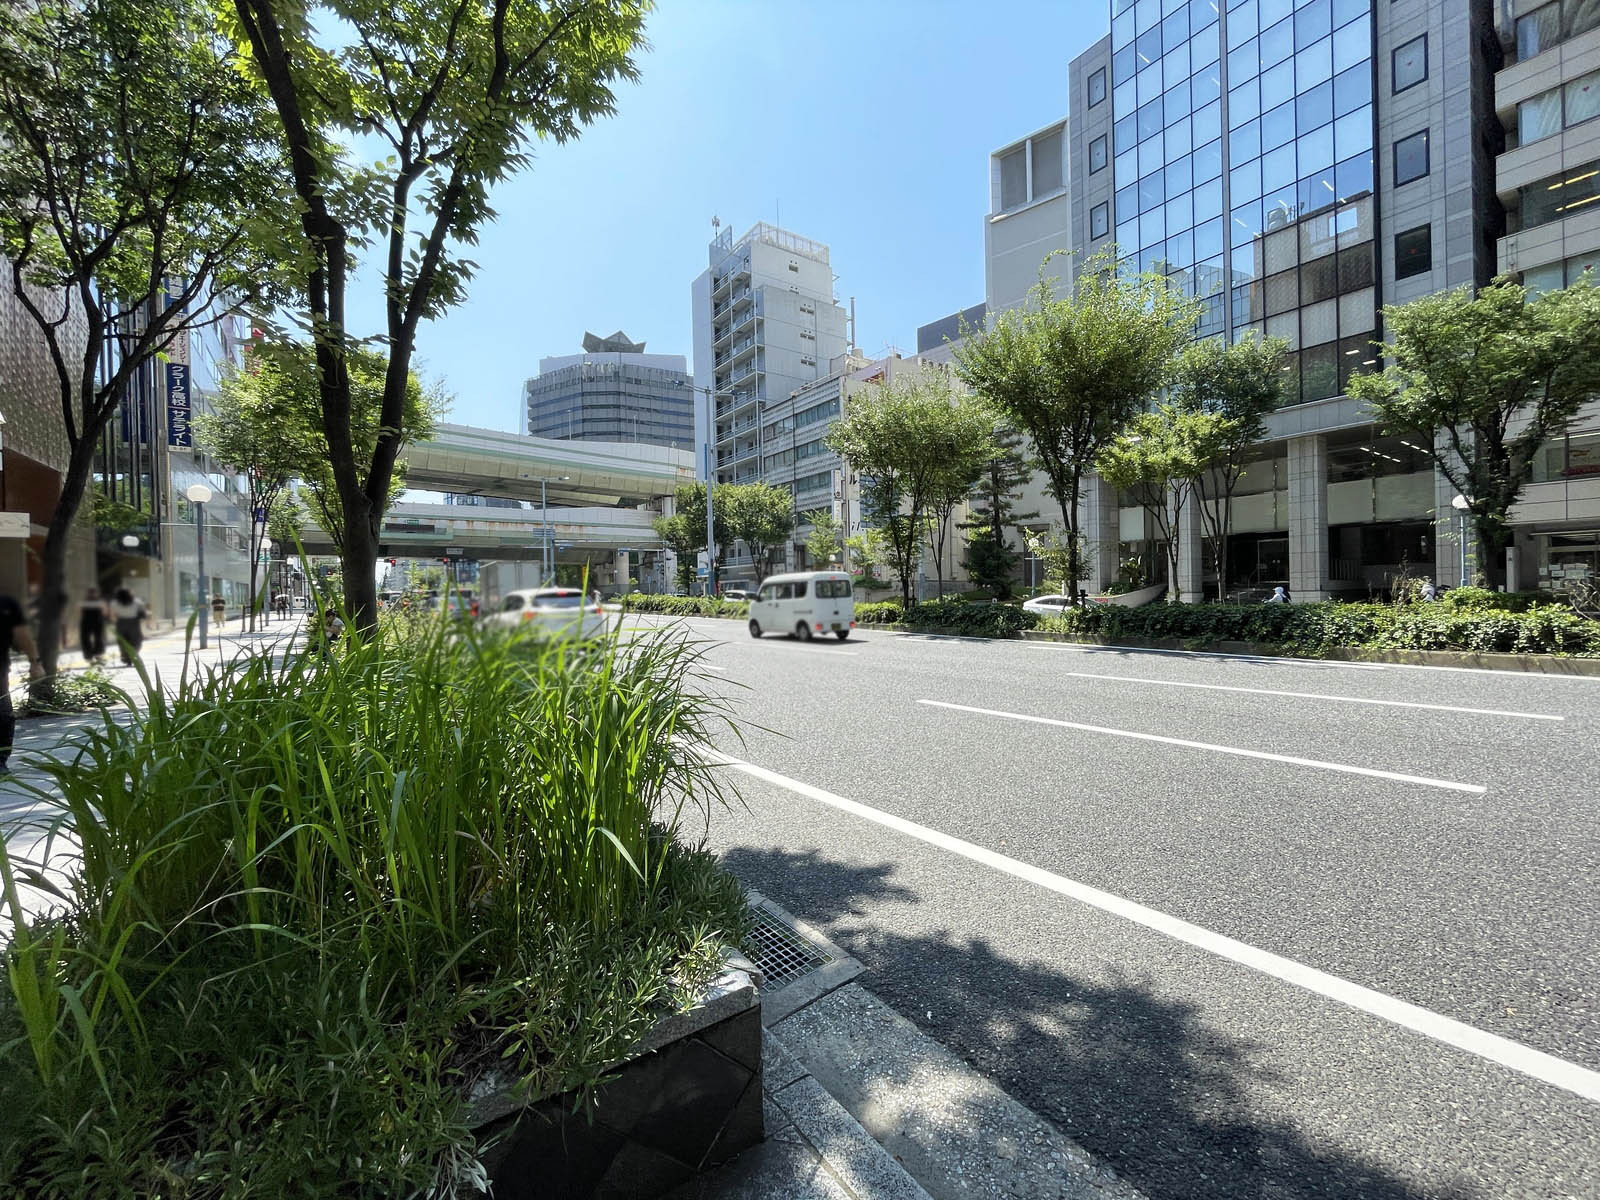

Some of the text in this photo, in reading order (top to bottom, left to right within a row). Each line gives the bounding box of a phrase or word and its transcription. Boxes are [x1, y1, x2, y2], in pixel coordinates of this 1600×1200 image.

[172, 365, 186, 407] クラーク高校
[172, 410, 187, 446] サテライト
